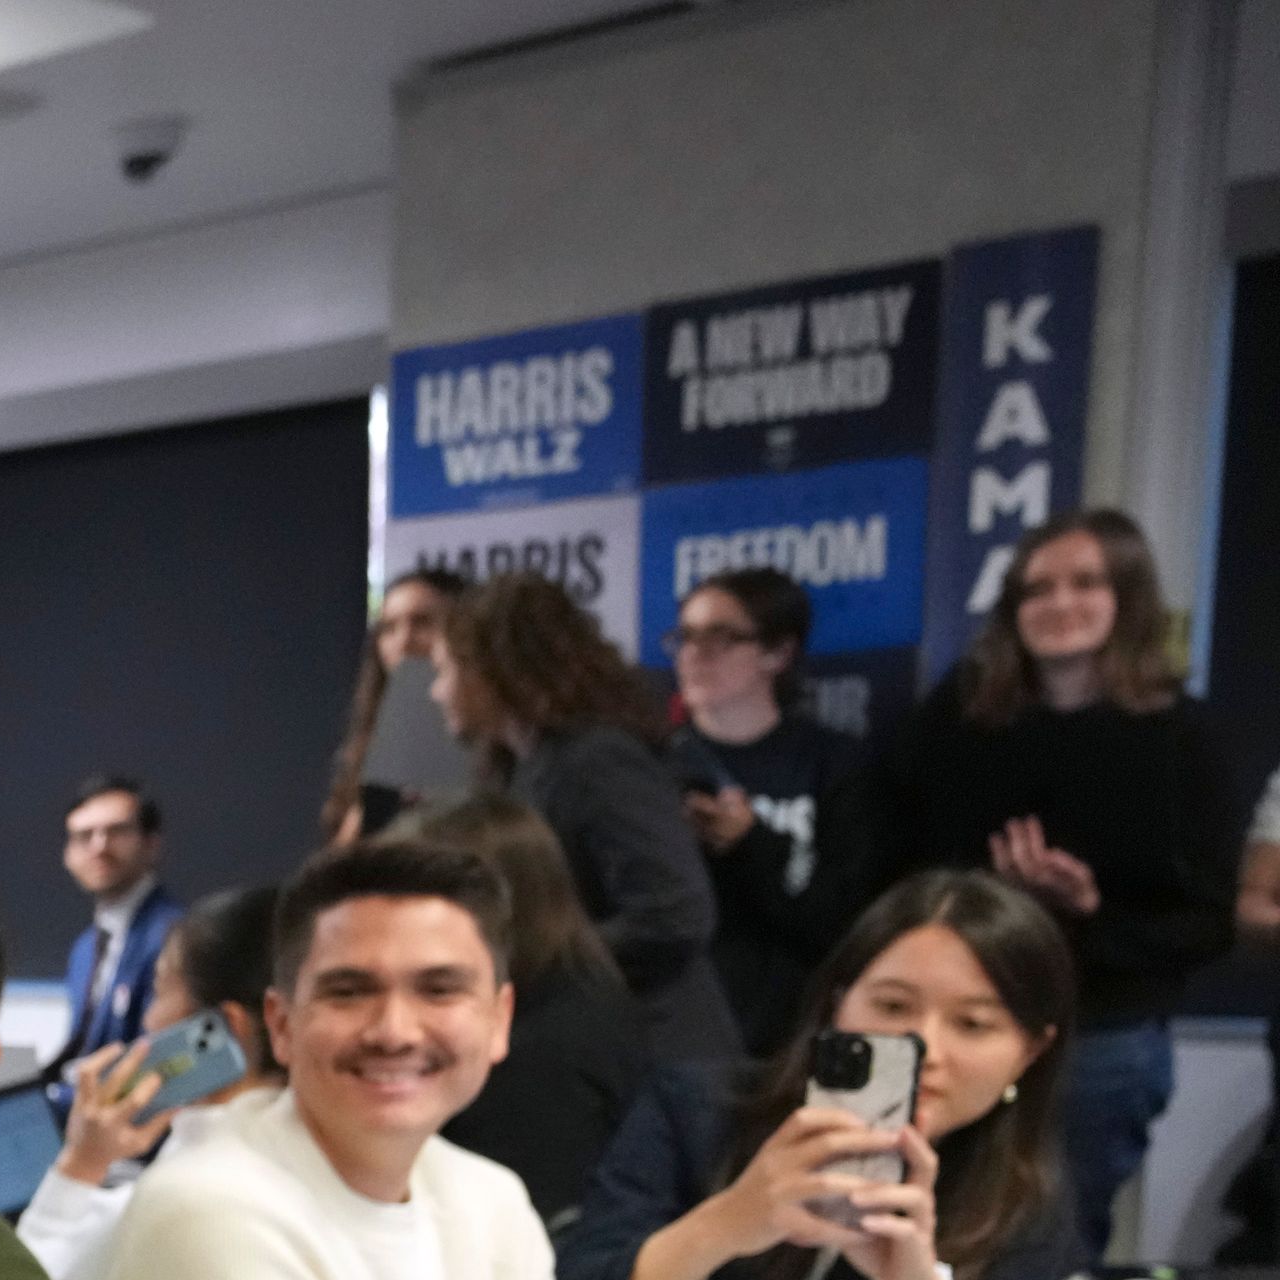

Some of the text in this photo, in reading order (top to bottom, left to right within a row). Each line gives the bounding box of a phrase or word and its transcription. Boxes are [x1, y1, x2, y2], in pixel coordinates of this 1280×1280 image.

[668, 286, 913, 379] A NEW WAY
[415, 347, 614, 448] HARRIS
[680, 350, 890, 432] FORWARD
[445, 429, 582, 486] WALZ
